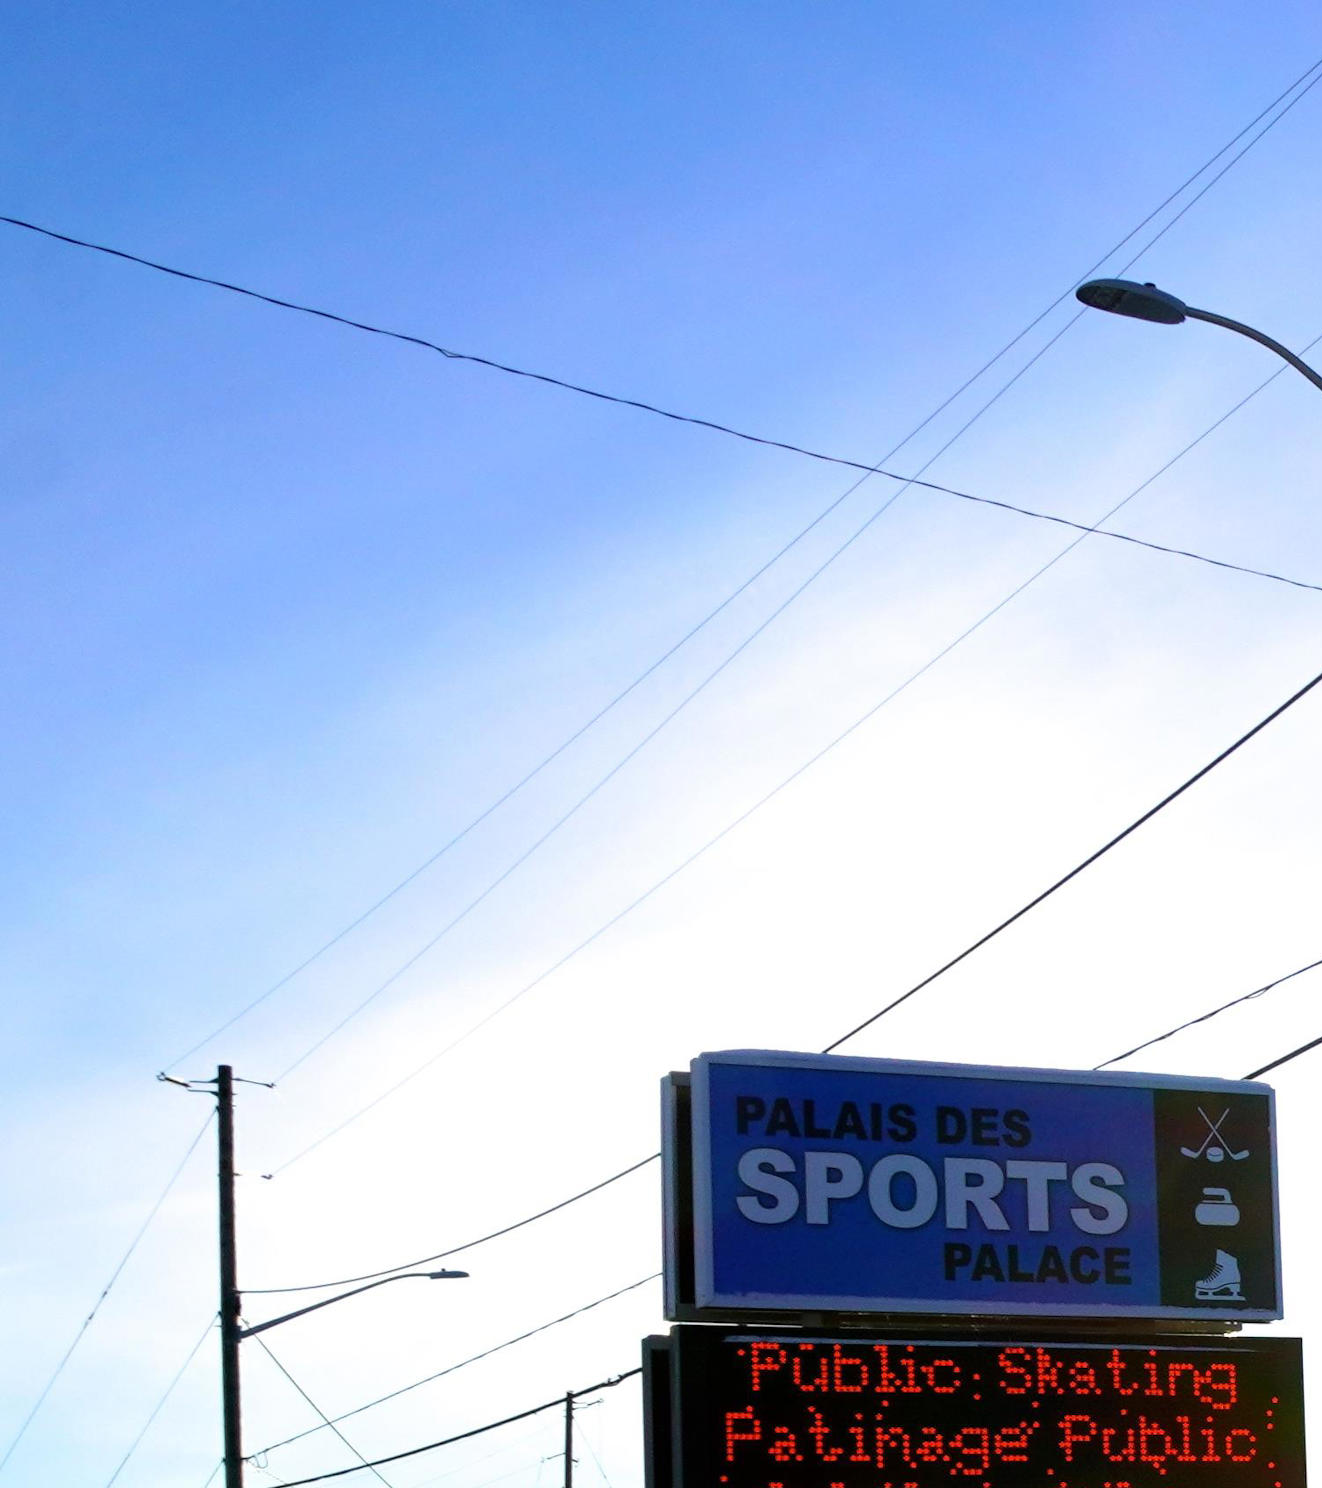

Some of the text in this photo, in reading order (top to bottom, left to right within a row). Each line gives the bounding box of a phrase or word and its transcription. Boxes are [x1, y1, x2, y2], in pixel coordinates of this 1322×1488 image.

[736, 1096, 1032, 1147] PALAIS DES
[736, 1147, 1130, 1236] SPORTS
[944, 1243, 1132, 1285] PALACE
[751, 1342, 1238, 1410] Public Skating
[725, 1411, 1257, 1476] Patinage Public
